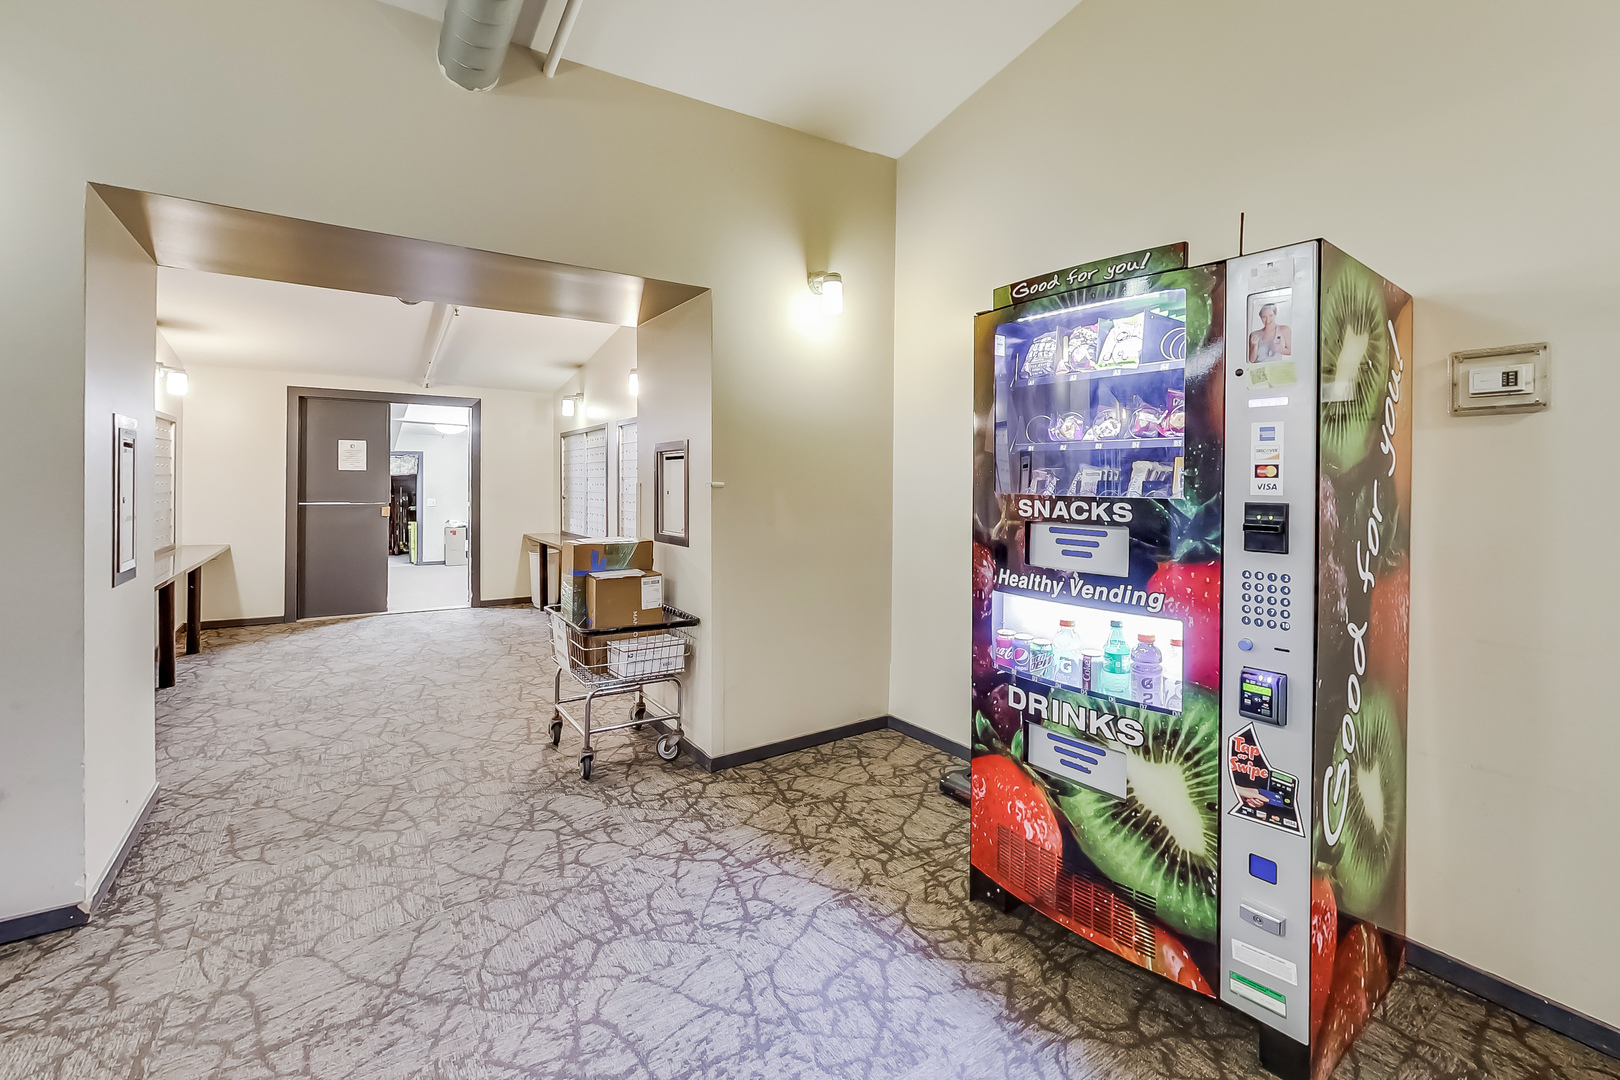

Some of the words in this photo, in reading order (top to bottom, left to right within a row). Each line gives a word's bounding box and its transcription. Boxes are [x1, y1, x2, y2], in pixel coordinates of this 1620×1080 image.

[1012, 274, 1060, 298] Good
[1066, 268, 1099, 285] for
[1103, 252, 1151, 280] you!
[1257, 483, 1278, 491] VISA
[1018, 499, 1133, 523] SNACKS
[998, 568, 1064, 598] Healthy
[1069, 578, 1166, 613] Vending
[1322, 621, 1368, 847] Good
[1357, 479, 1382, 594] for
[1380, 319, 1404, 478] you!
[1060, 660, 1072, 674] G
[1083, 659, 1091, 682] Coke
[1008, 684, 1146, 747] DRINKS
[1233, 736, 1260, 760] Tap
[1229, 756, 1269, 781] Swipe
